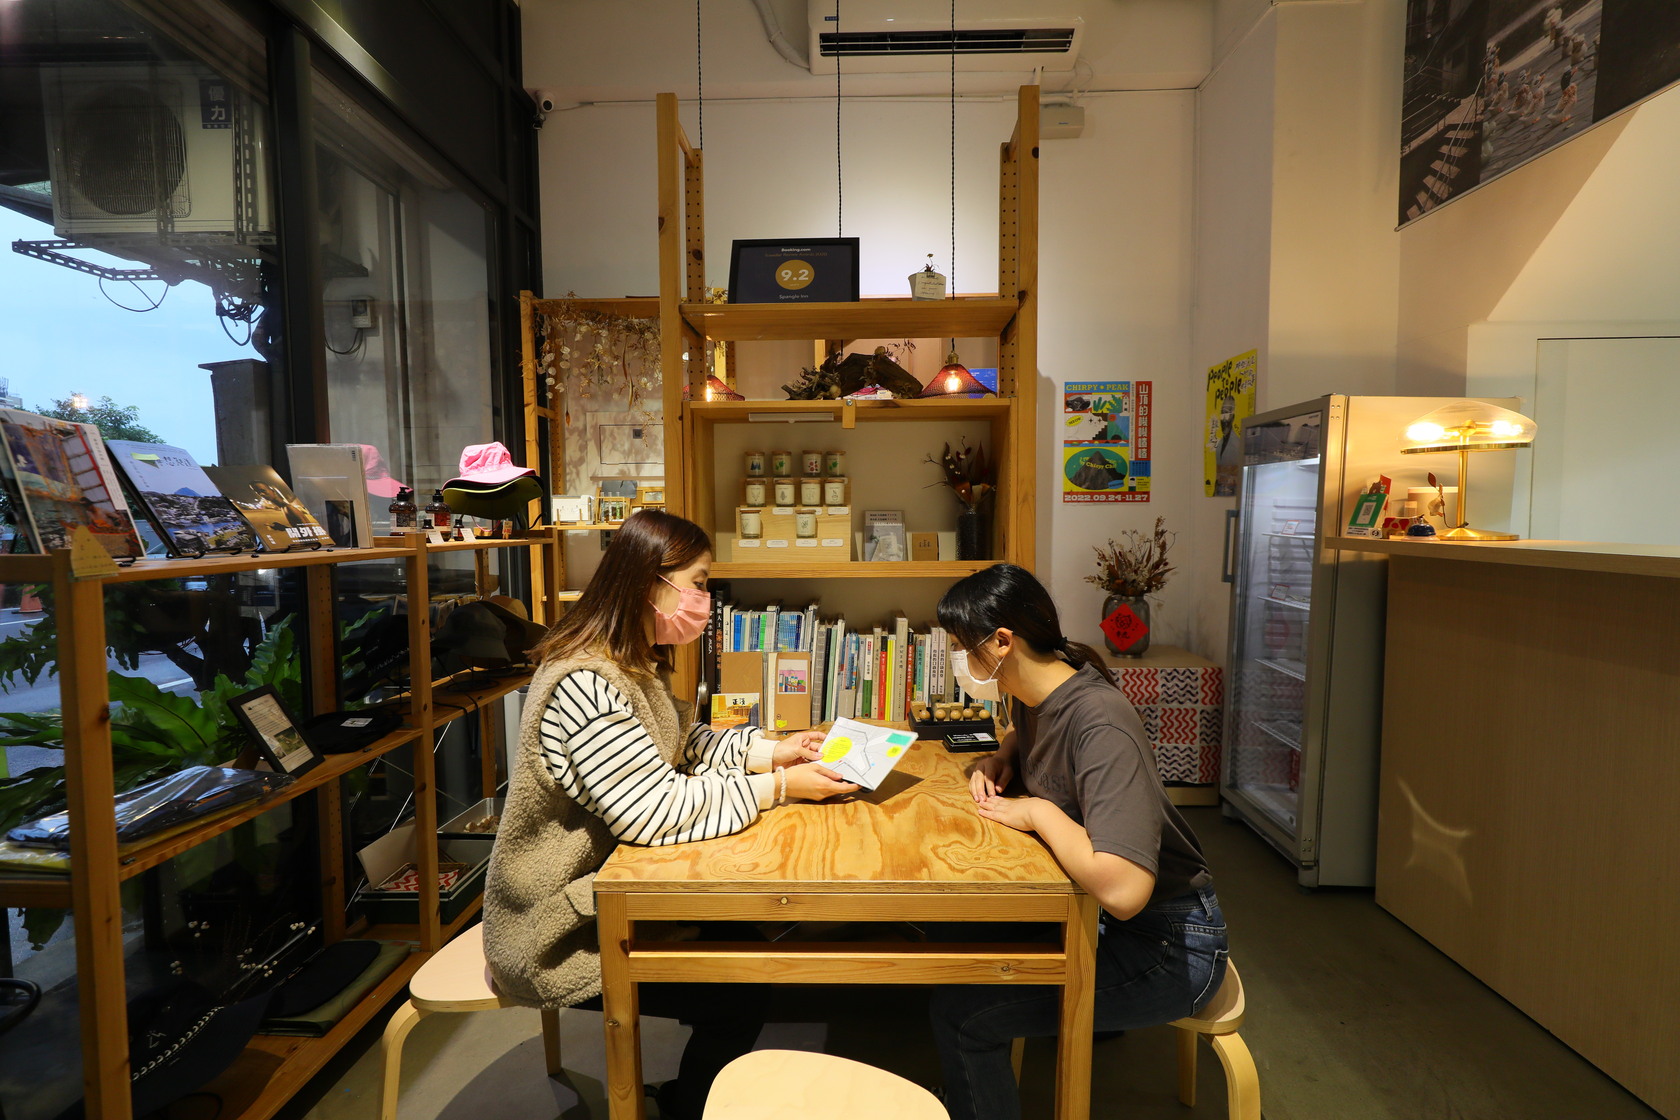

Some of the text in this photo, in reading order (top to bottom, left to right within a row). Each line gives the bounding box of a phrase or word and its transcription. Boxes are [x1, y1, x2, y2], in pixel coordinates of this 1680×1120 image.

[781, 269, 809, 281] 9.2
[1106, 383, 1129, 391] PEAK
[1064, 494, 1148, 502] 2022.09.24-11.27
